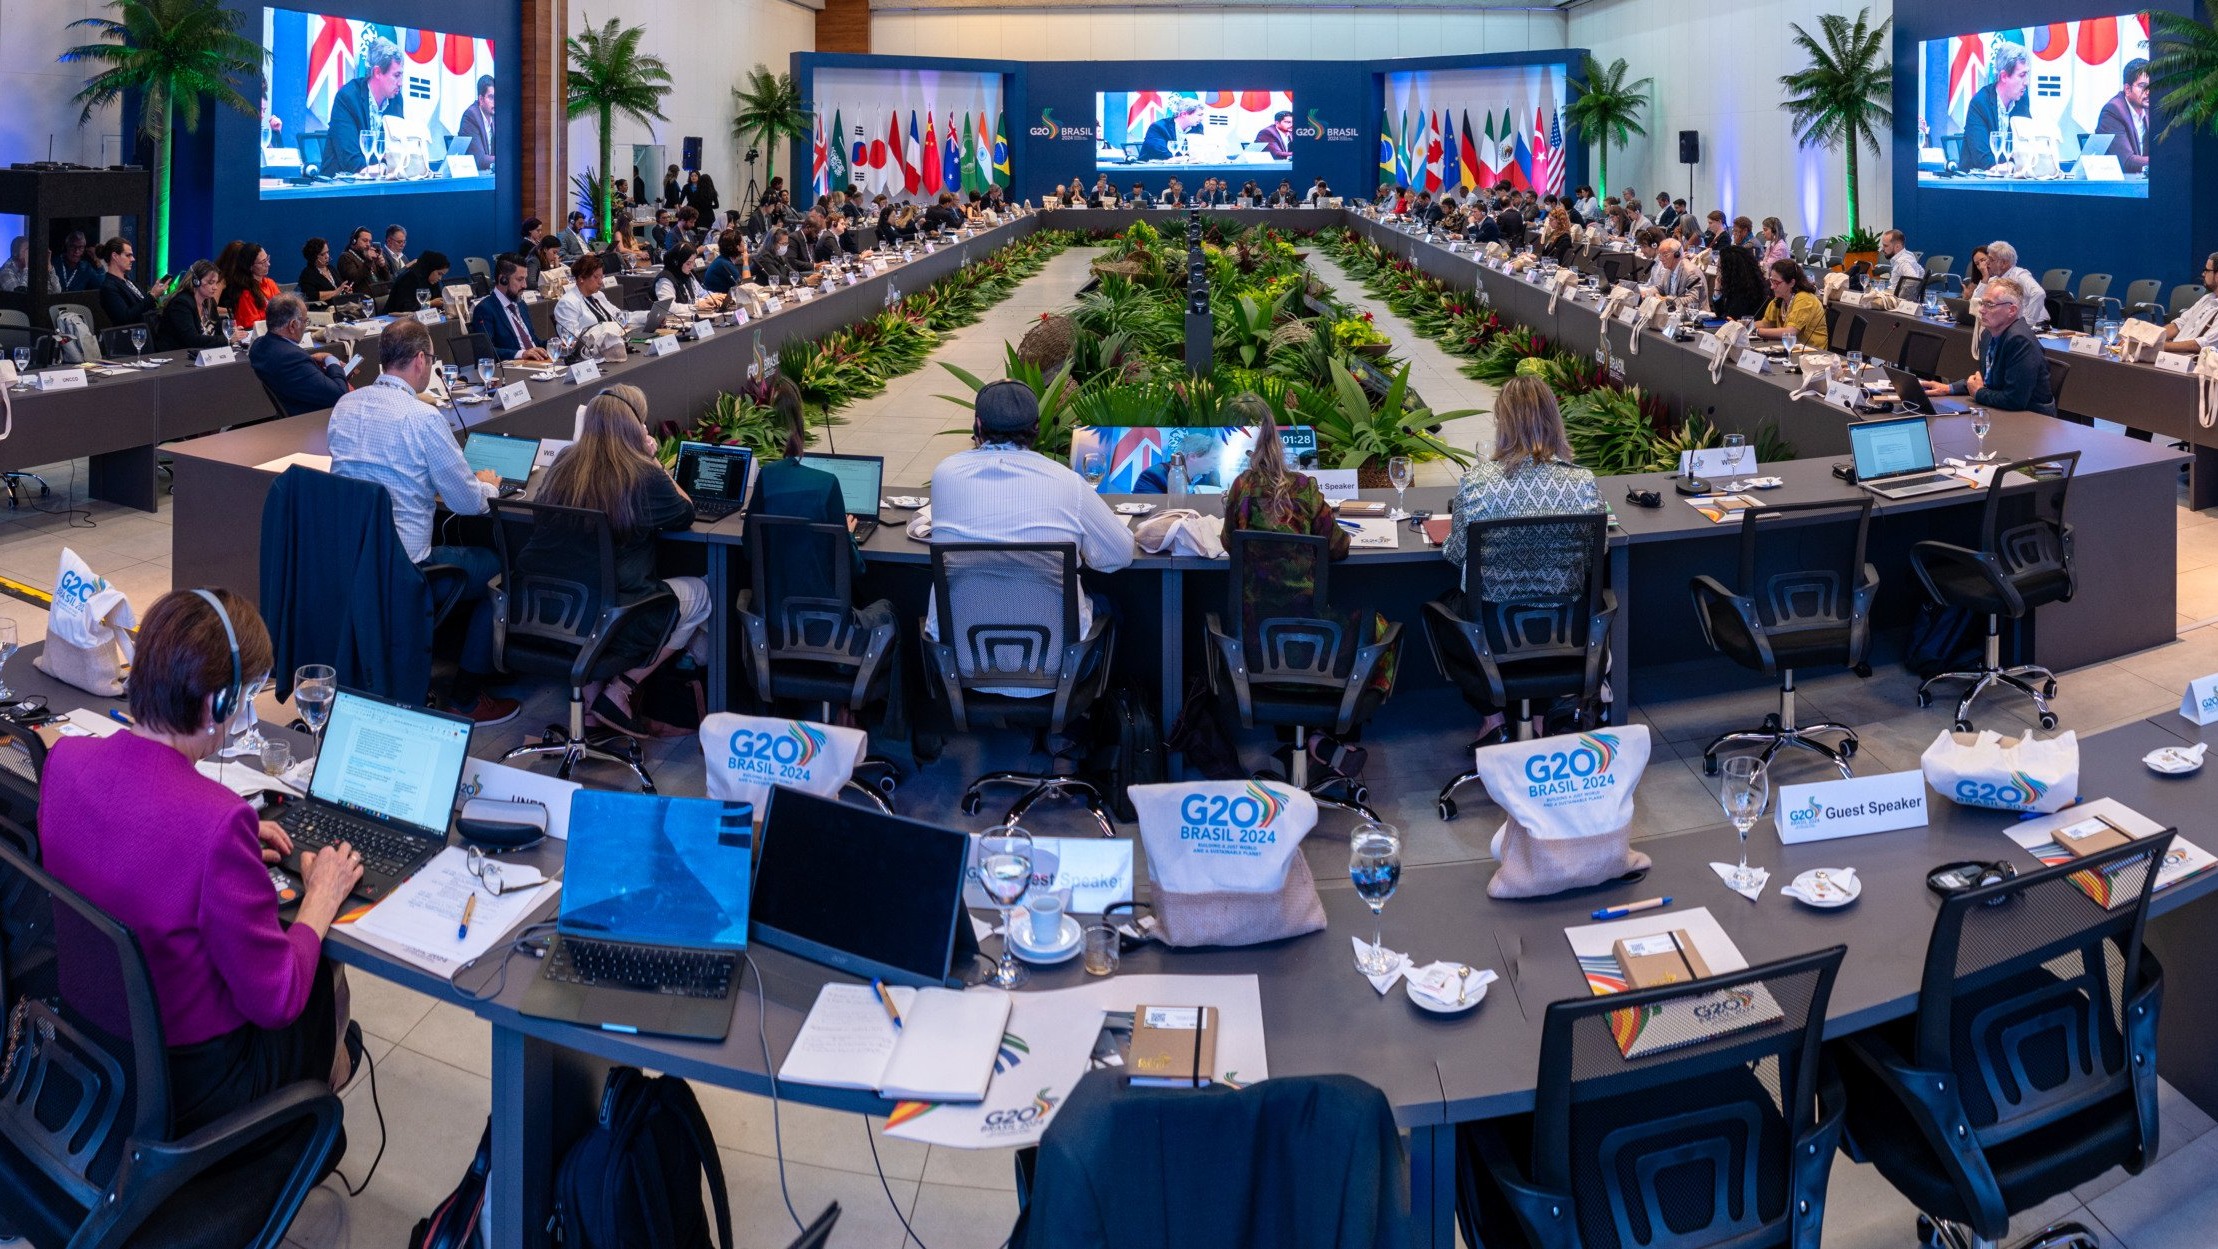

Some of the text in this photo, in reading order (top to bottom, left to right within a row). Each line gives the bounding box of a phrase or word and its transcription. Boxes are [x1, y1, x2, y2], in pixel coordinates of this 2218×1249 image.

[1030, 127, 1093, 136] G20 BRASIL
[1296, 128, 1358, 136] G20 BRASIL
[62, 570, 95, 602] G20
[730, 729, 799, 764] G20
[728, 757, 811, 781] BRASIL 2024
[1525, 748, 1596, 783] G20
[459, 782, 475, 796] 20
[1529, 774, 1615, 797] BRASIL 2024
[1956, 779, 2022, 803] G20
[1181, 794, 1259, 828] G20
[1790, 809, 1814, 821] G20
[1825, 797, 1922, 819] Guest Speaker
[1181, 826, 1276, 844] BRASIL 2024
[1060, 873, 1126, 888] Speaker
[1694, 999, 1740, 1019] G20
[985, 1106, 1037, 1125] G20
